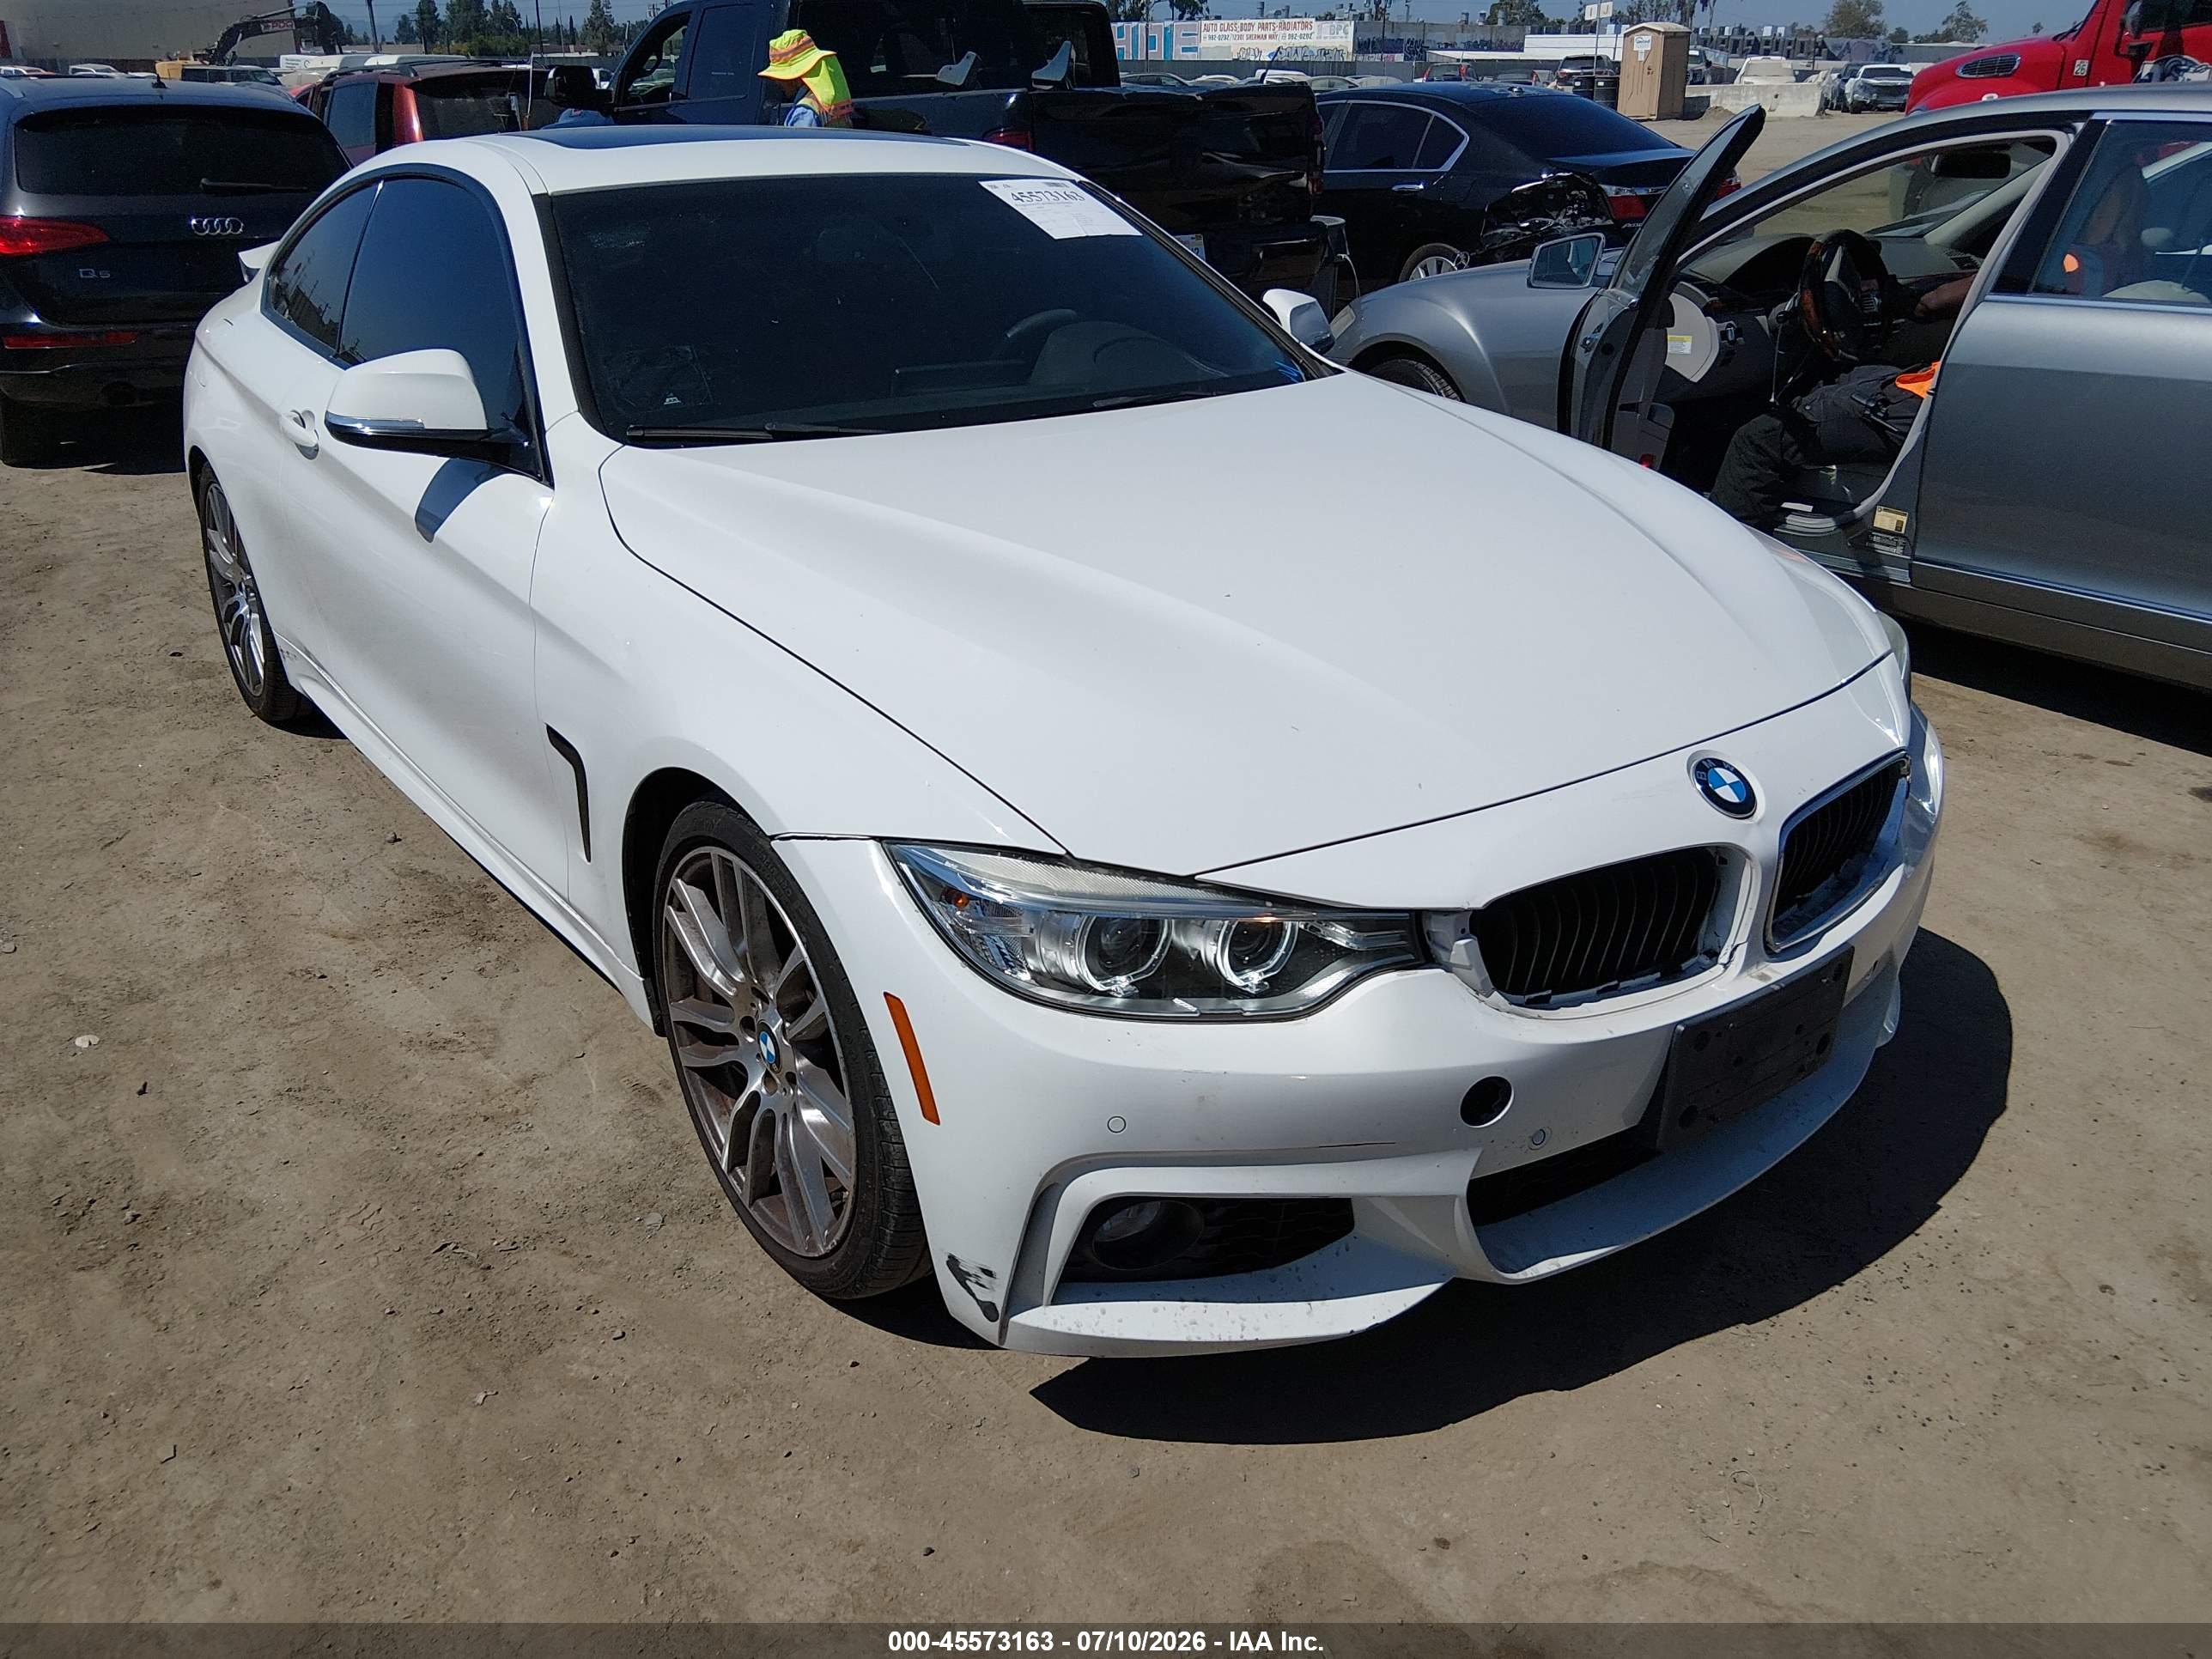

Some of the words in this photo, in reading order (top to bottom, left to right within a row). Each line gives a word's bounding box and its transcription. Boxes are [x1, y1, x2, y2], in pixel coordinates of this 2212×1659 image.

[1202, 22, 1218, 32] AUTO
[1219, 22, 1237, 32] GLASS
[1239, 21, 1255, 32] BODY
[1257, 21, 1276, 32] PARTS
[1278, 21, 1313, 31] RADIATORS
[2075, 64, 2087, 75] 26
[1010, 191, 1086, 203] 45573163
[78, 268, 111, 279] Q5
